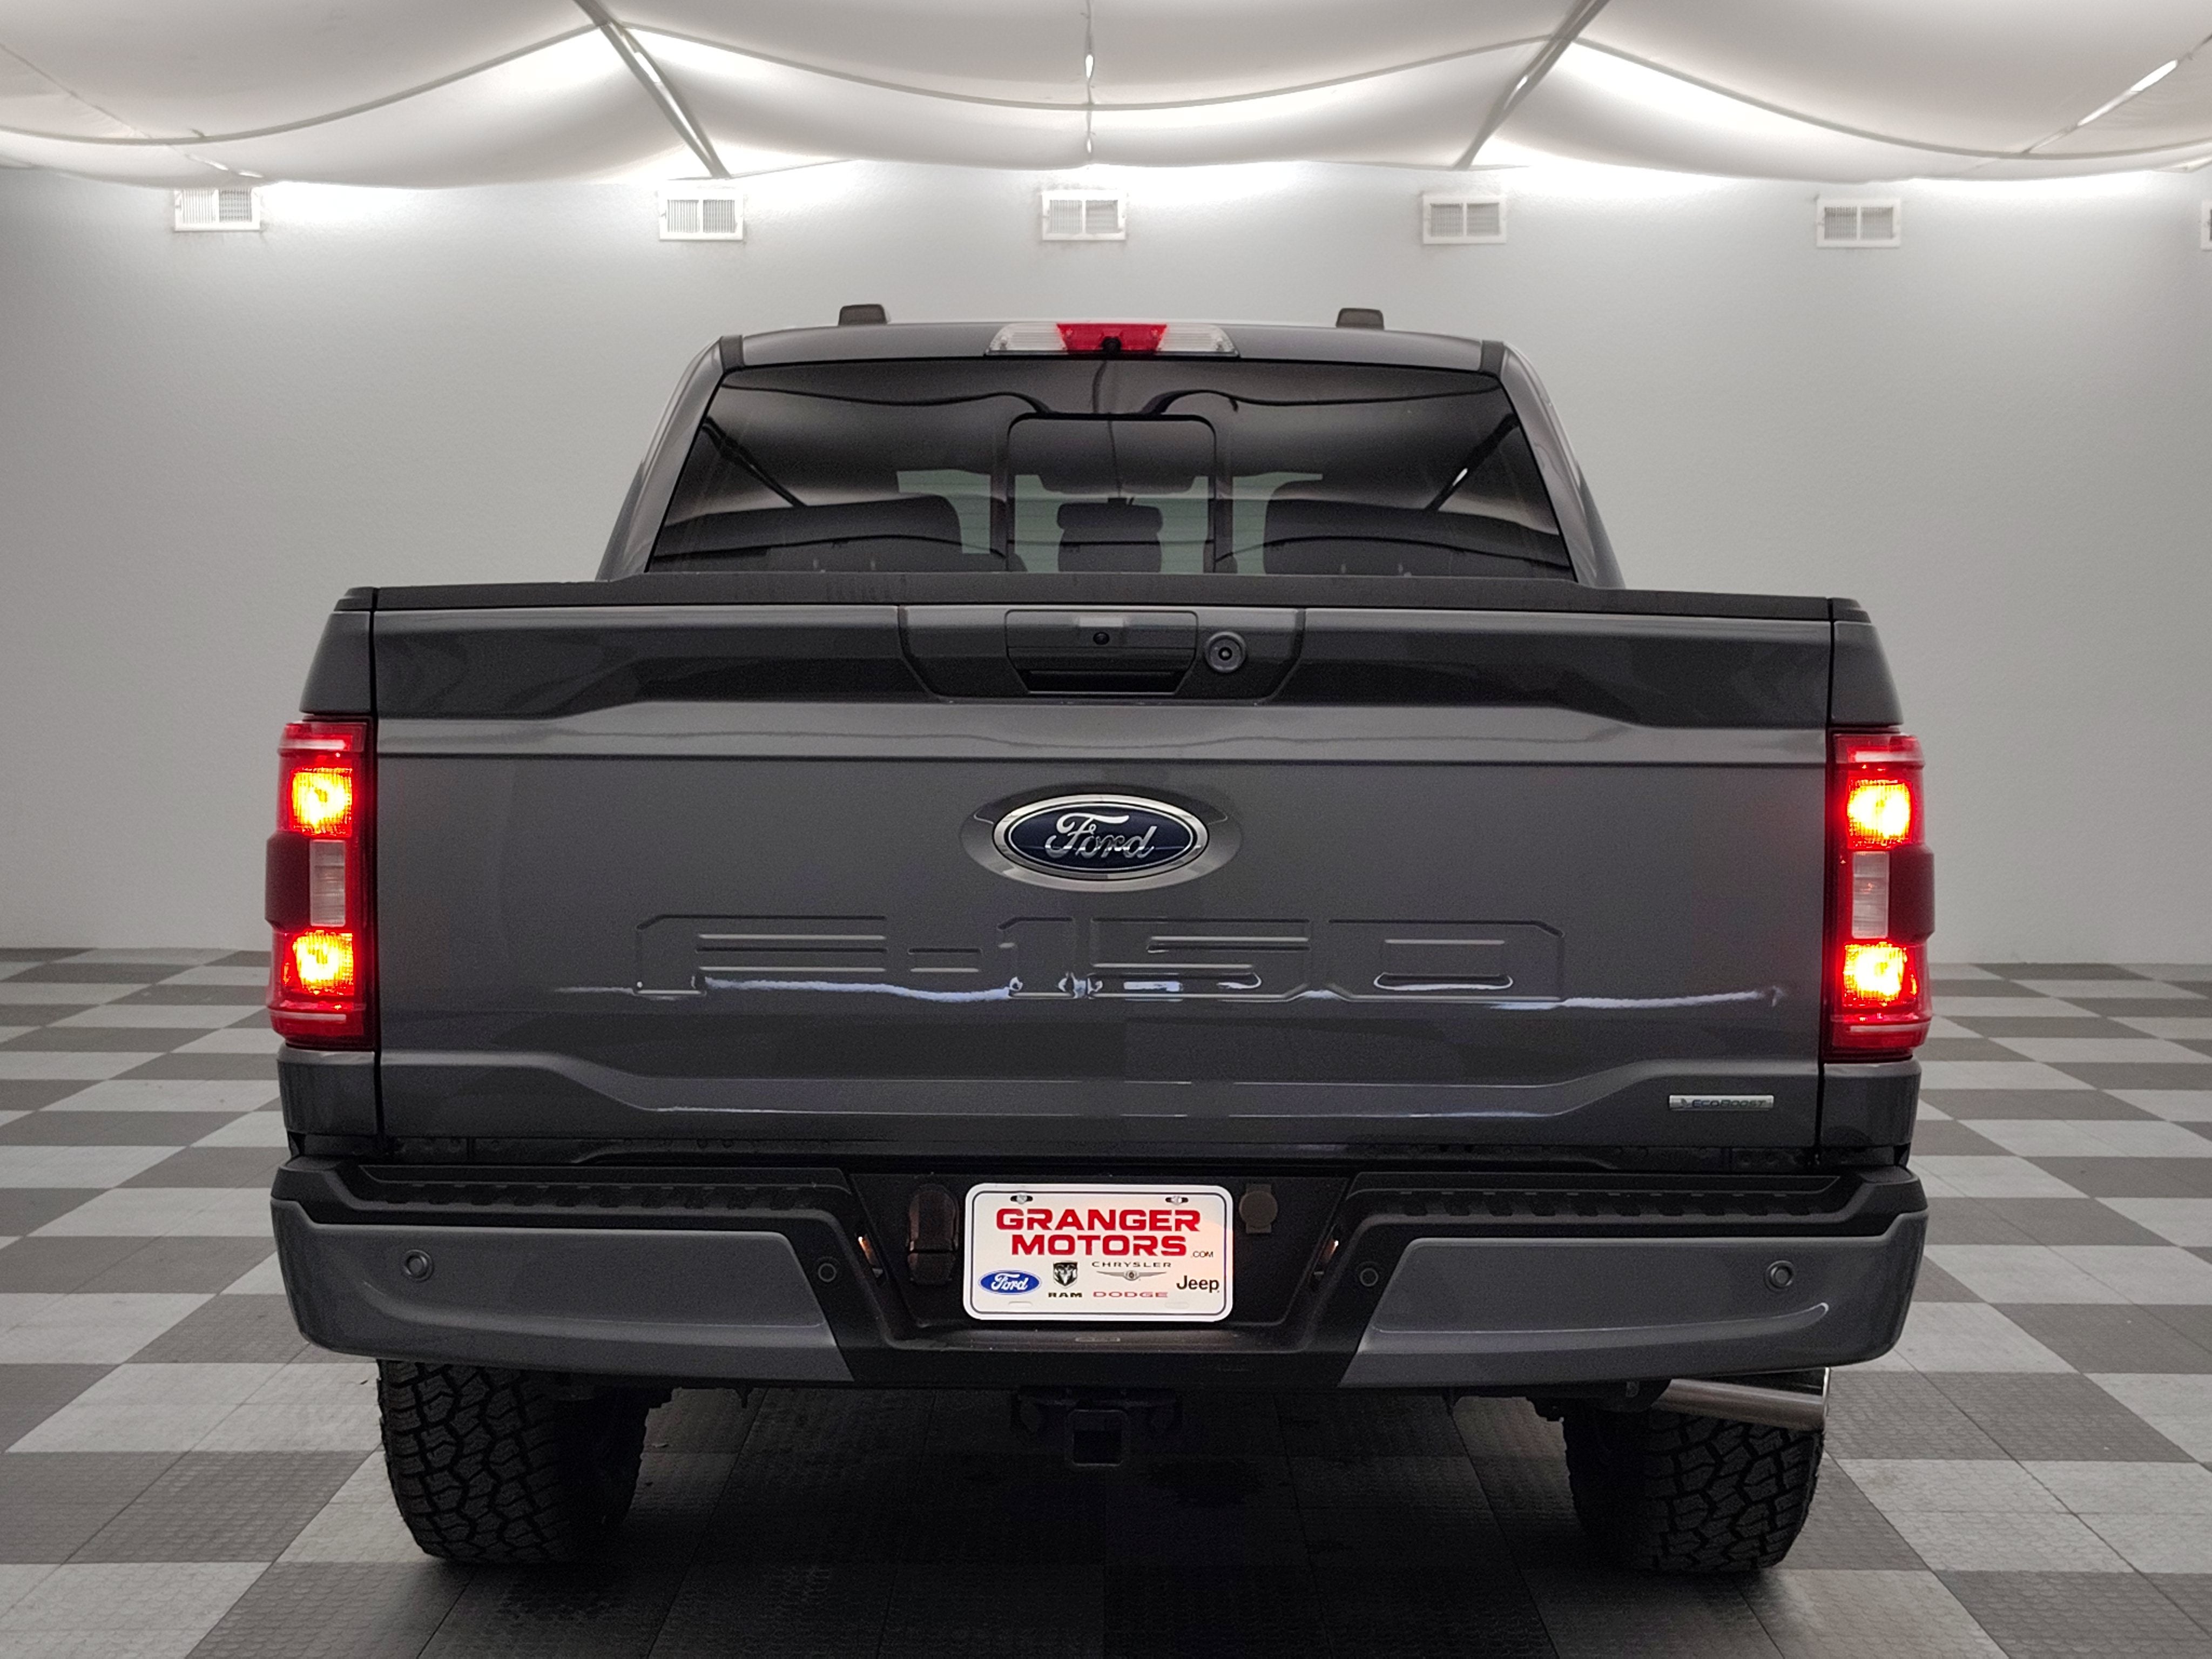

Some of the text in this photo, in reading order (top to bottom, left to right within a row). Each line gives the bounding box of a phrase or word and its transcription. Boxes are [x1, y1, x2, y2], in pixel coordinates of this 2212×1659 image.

[1044, 812, 1157, 859] Ford
[996, 1208, 1201, 1231] GRANGER
[1011, 1234, 1187, 1256] MOTORS
[990, 1273, 1028, 1291] Ford
[1176, 1275, 1220, 1293] Jeep
